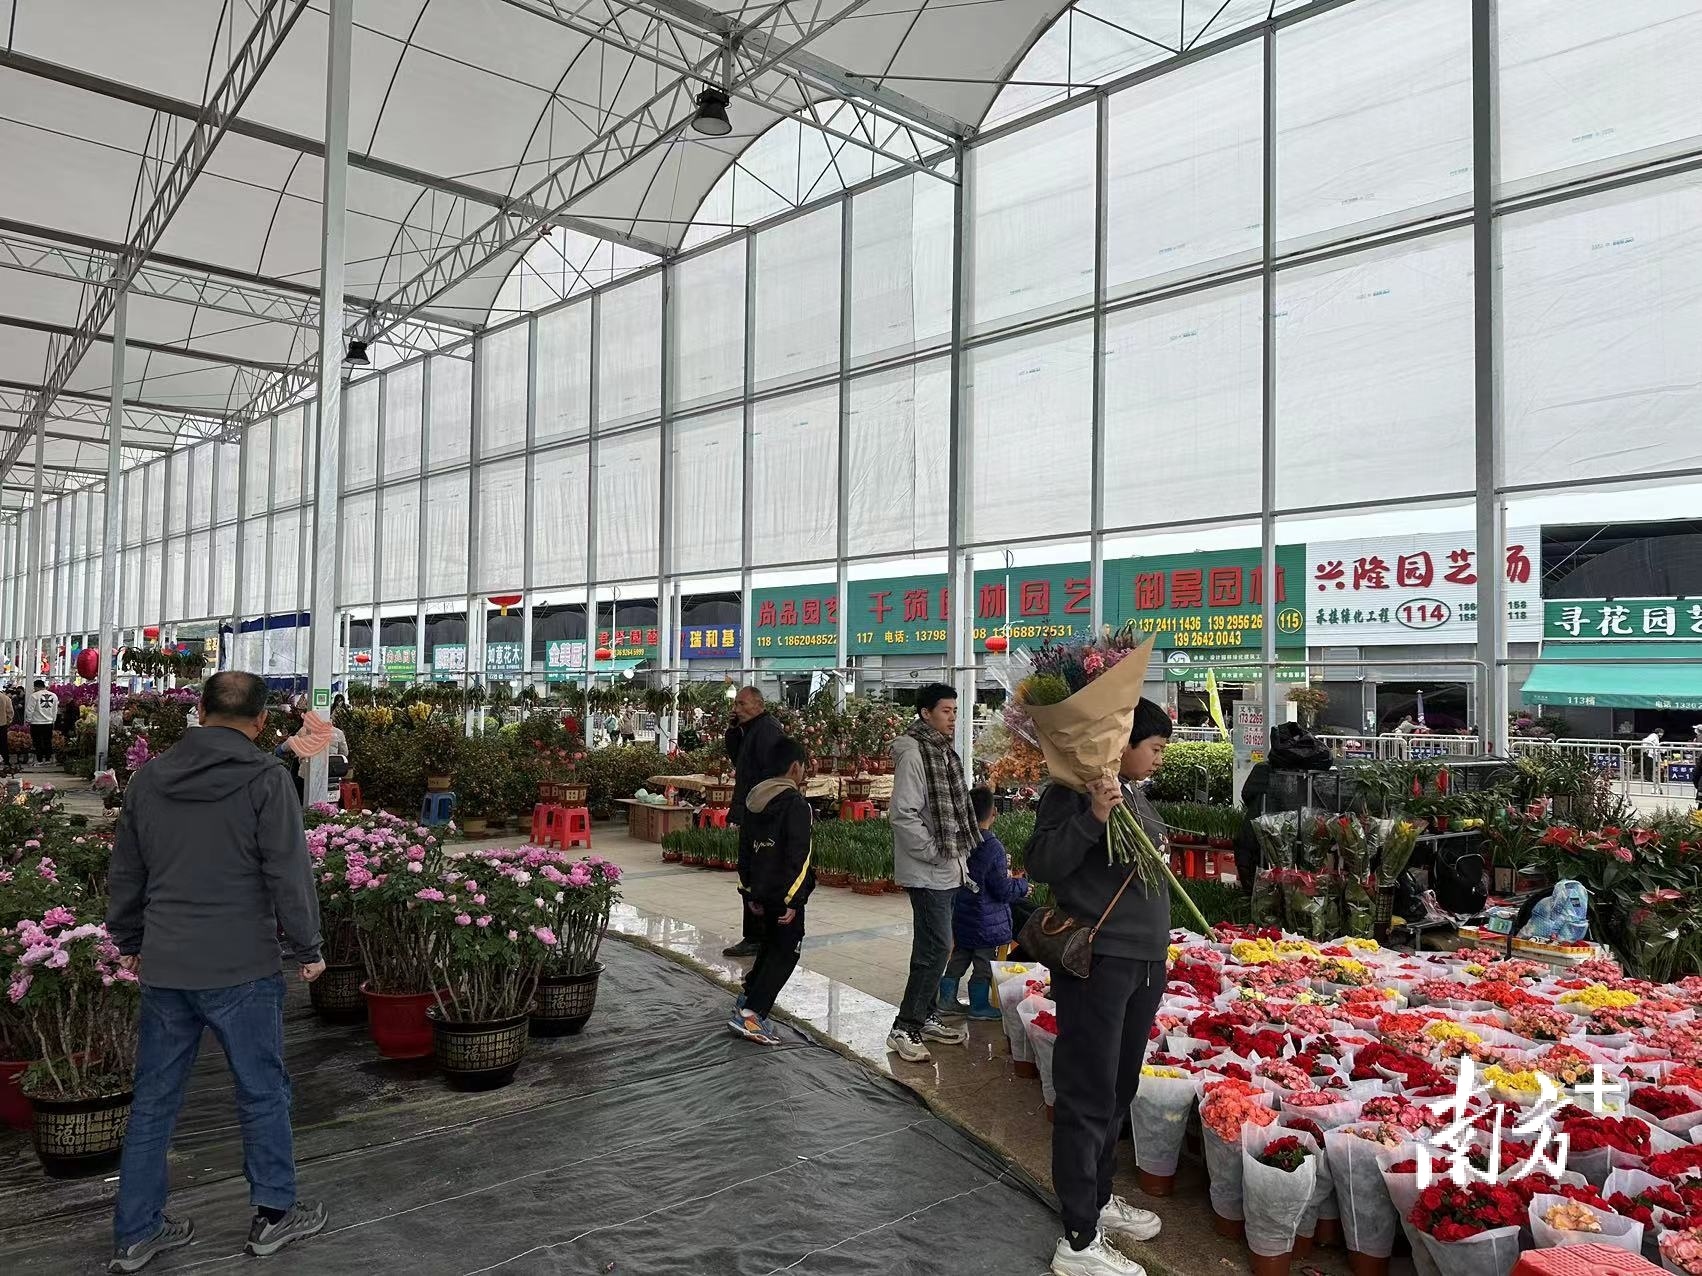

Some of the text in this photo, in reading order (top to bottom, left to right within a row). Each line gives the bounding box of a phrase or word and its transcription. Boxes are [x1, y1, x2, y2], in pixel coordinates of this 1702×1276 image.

[1135, 565, 1286, 610] 御景园林
[1280, 613, 1299, 629] 115
[1402, 603, 1444, 623] 114
[1139, 618, 1154, 632] 137
[1156, 617, 1176, 632] 2411
[1179, 617, 1201, 631] 1436
[1208, 616, 1224, 630] 139
[1227, 615, 1249, 630] 2956
[690, 628, 735, 648] 瑞和基
[757, 636, 773, 647] 118
[857, 632, 873, 643] 117
[1174, 631, 1241, 647] 139 2642 0043
[487, 644, 523, 664] 如意花木
[549, 642, 586, 667] 金美园
[54, 1124, 76, 1146] 福
